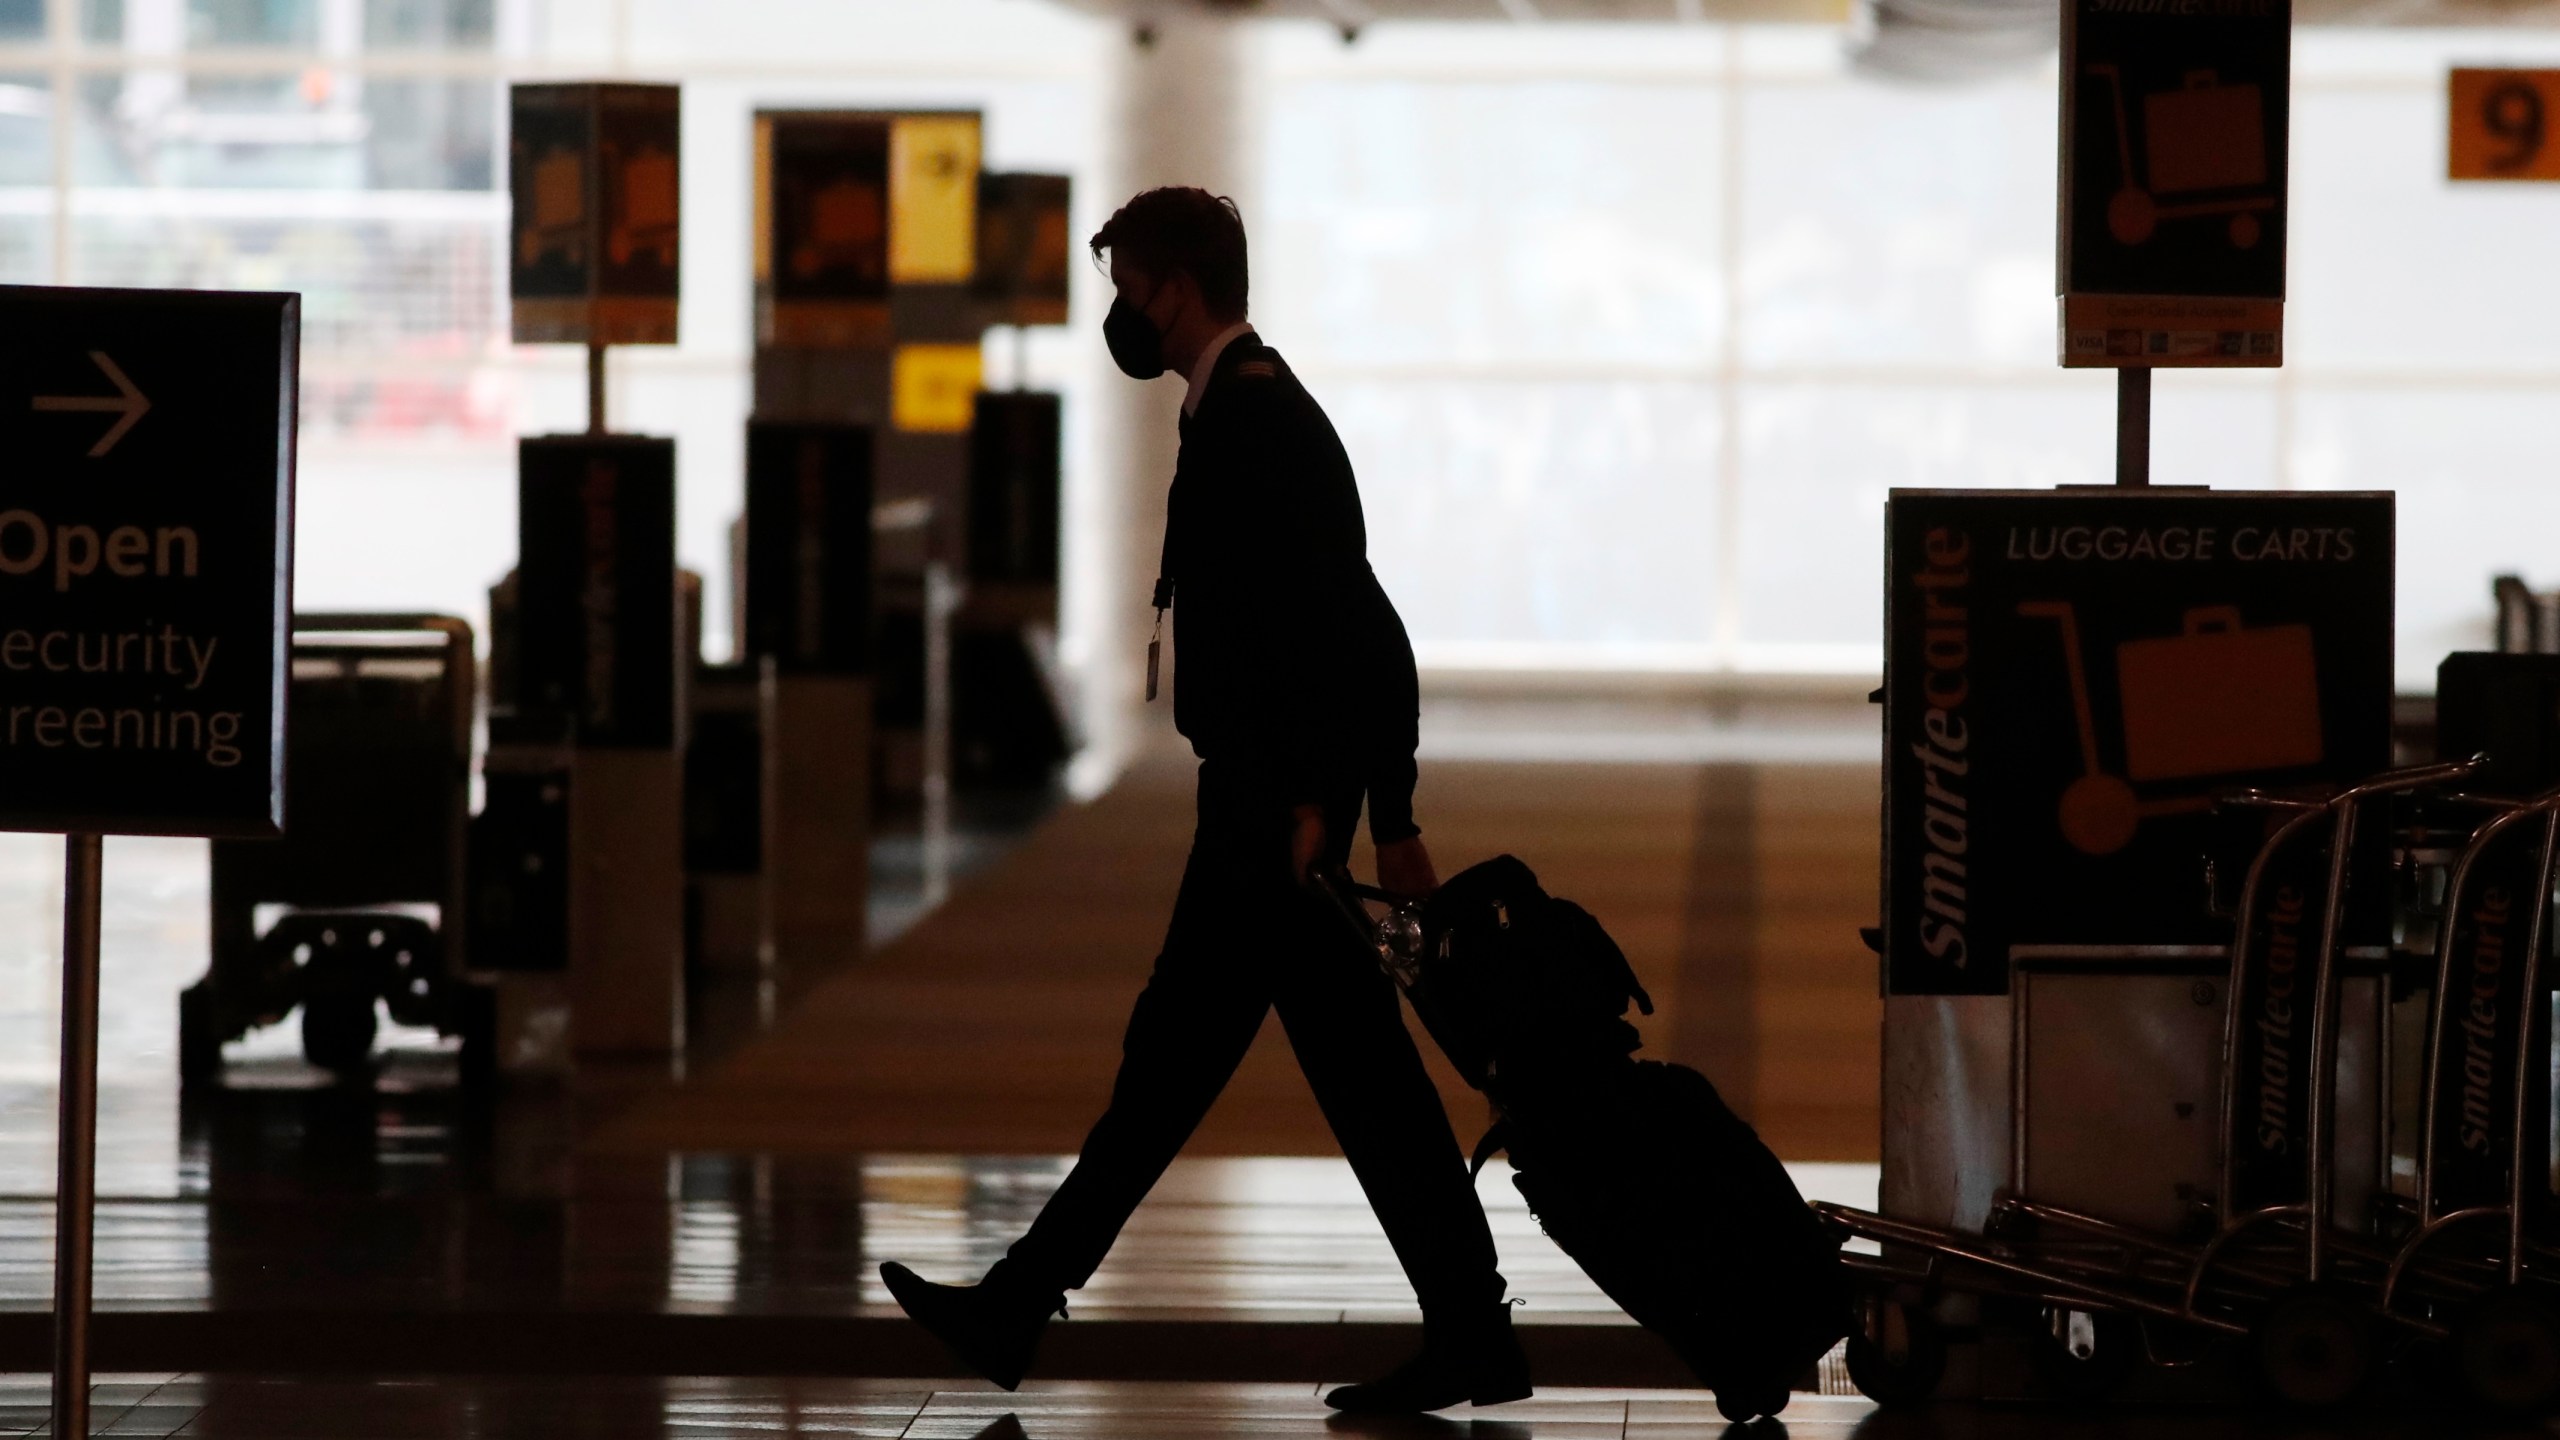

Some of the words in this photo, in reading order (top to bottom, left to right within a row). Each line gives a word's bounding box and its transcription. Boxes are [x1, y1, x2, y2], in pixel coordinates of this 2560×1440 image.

[2483, 77, 2545, 177] 9
[2076, 337, 2104, 348] VISA
[0, 507, 201, 593] Open
[2005, 525, 2216, 563] LUGGAGE
[2230, 526, 2356, 563] CARTS
[0, 617, 219, 690] ecurity
[1911, 524, 1975, 969] smartecarte
[2254, 883, 2304, 1155] smartecarte
[2459, 885, 2513, 1157] smartecarte
